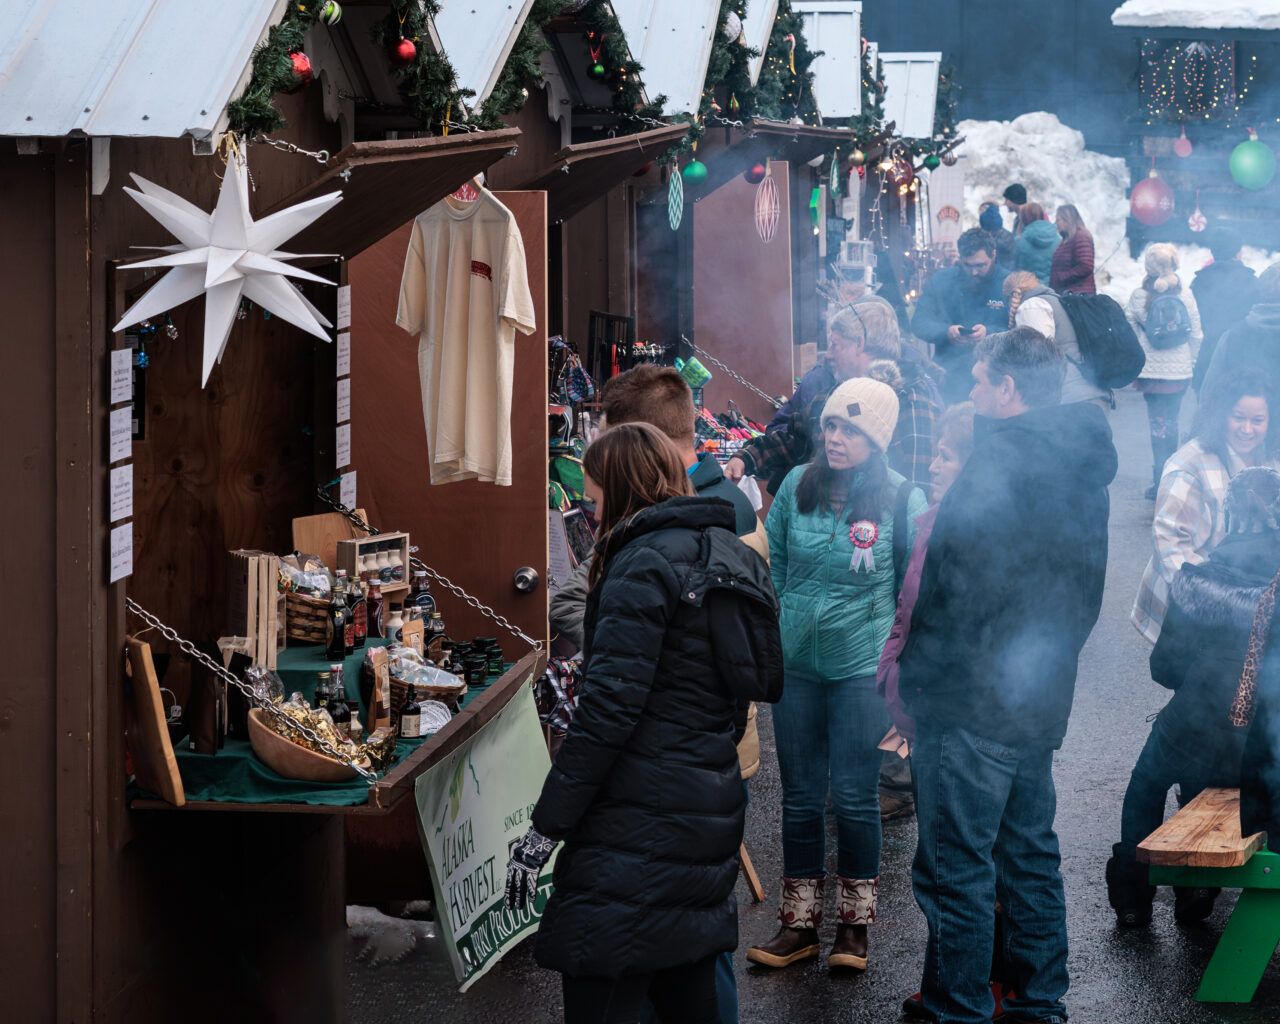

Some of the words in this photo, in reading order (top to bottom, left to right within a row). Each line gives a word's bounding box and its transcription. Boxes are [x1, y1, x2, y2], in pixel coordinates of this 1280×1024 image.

[441, 815, 476, 886] ALASKA
[503, 808, 524, 833] SINCE
[449, 854, 496, 934] HARVEST
